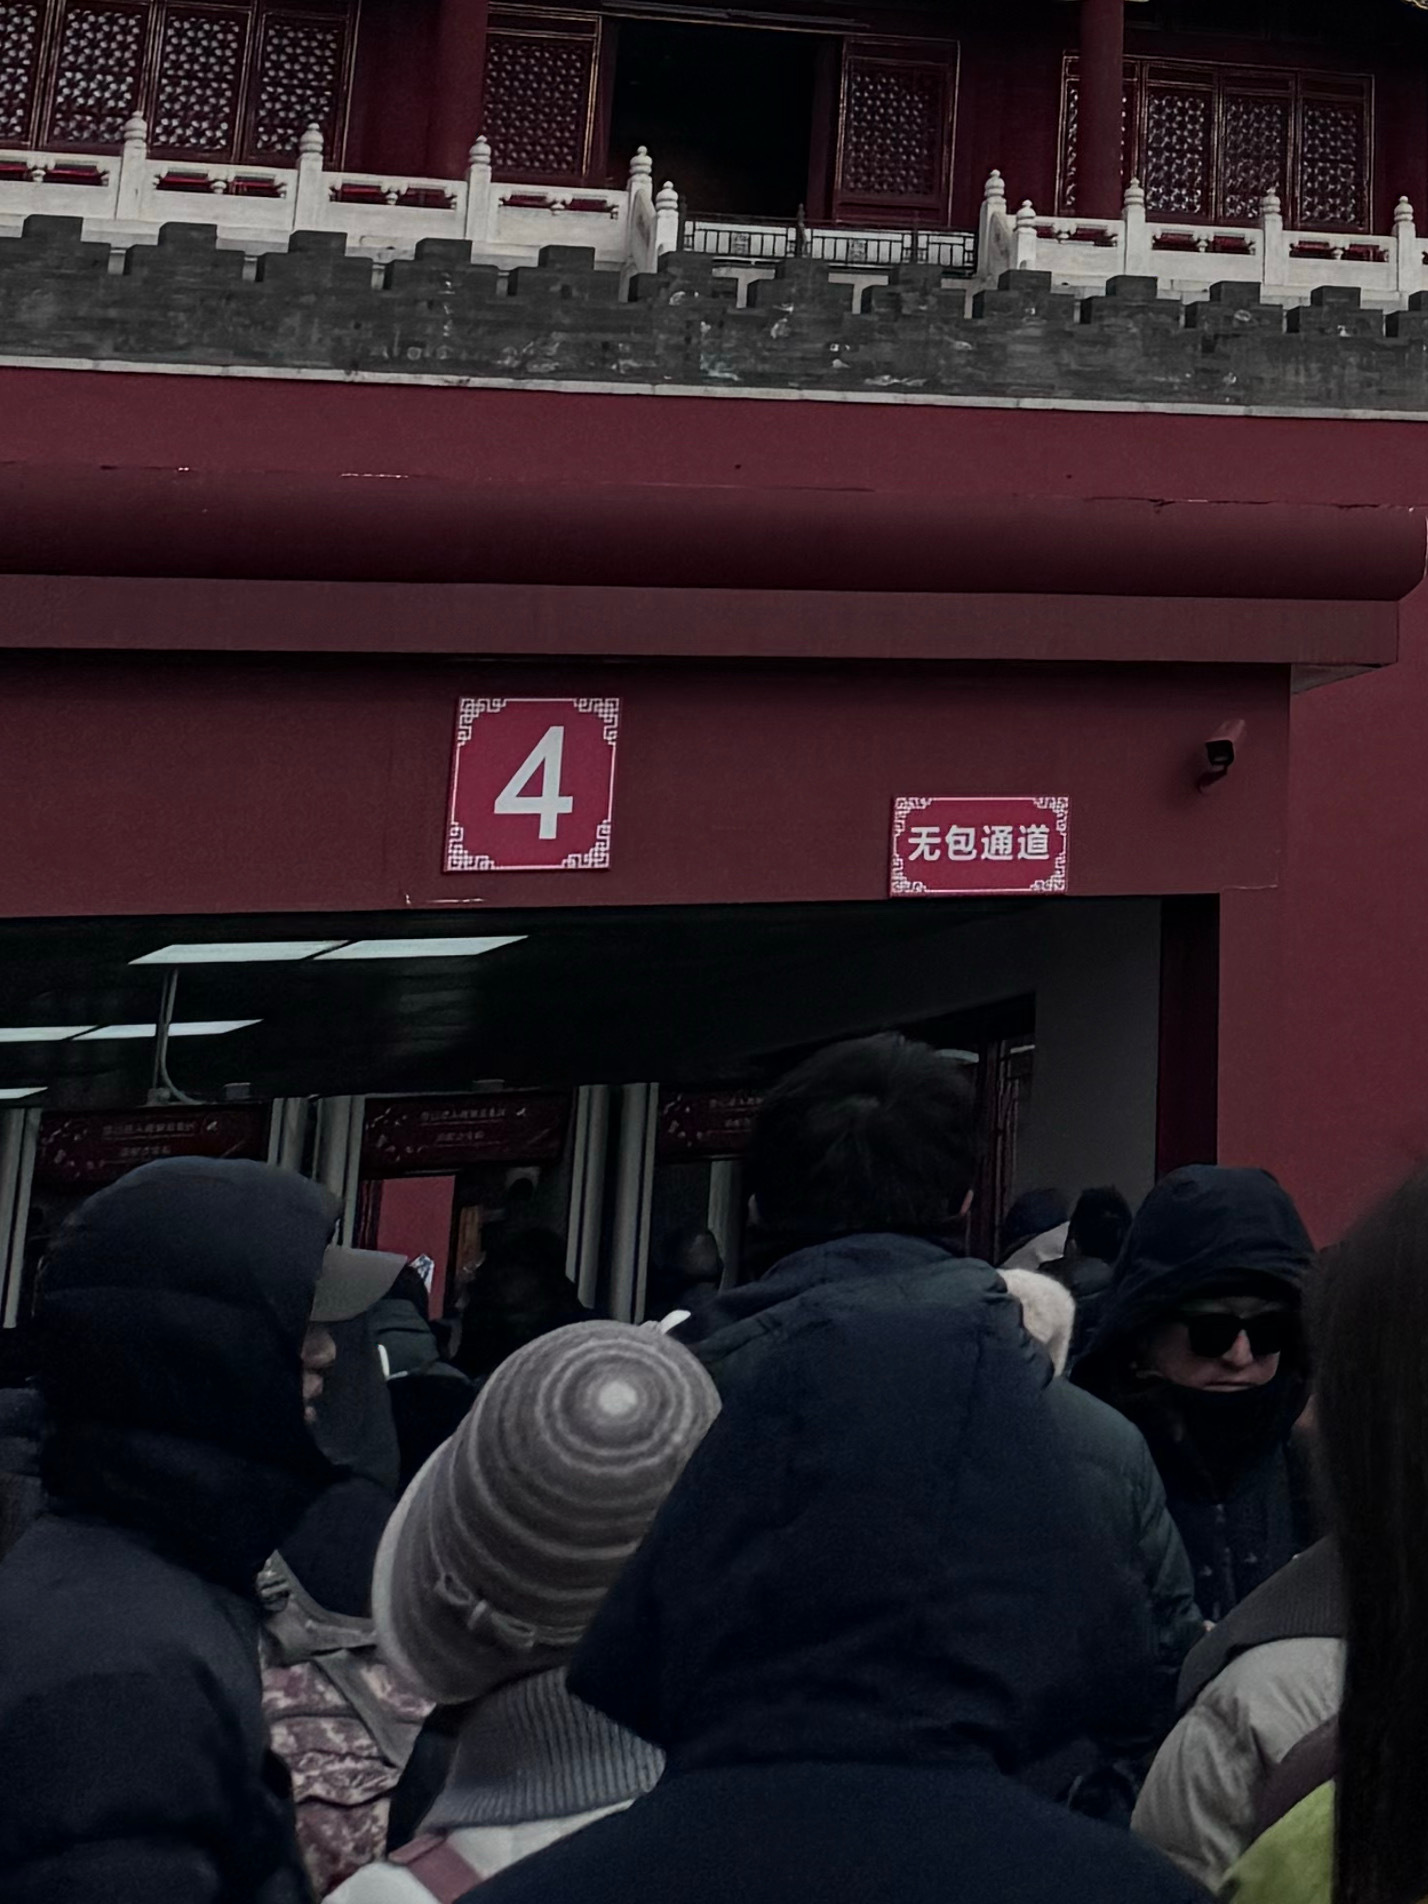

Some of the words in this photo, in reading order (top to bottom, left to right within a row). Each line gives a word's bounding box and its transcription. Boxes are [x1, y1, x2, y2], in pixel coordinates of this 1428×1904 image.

[494, 725, 573, 840] 4
[908, 824, 1050, 861] 无包通道
